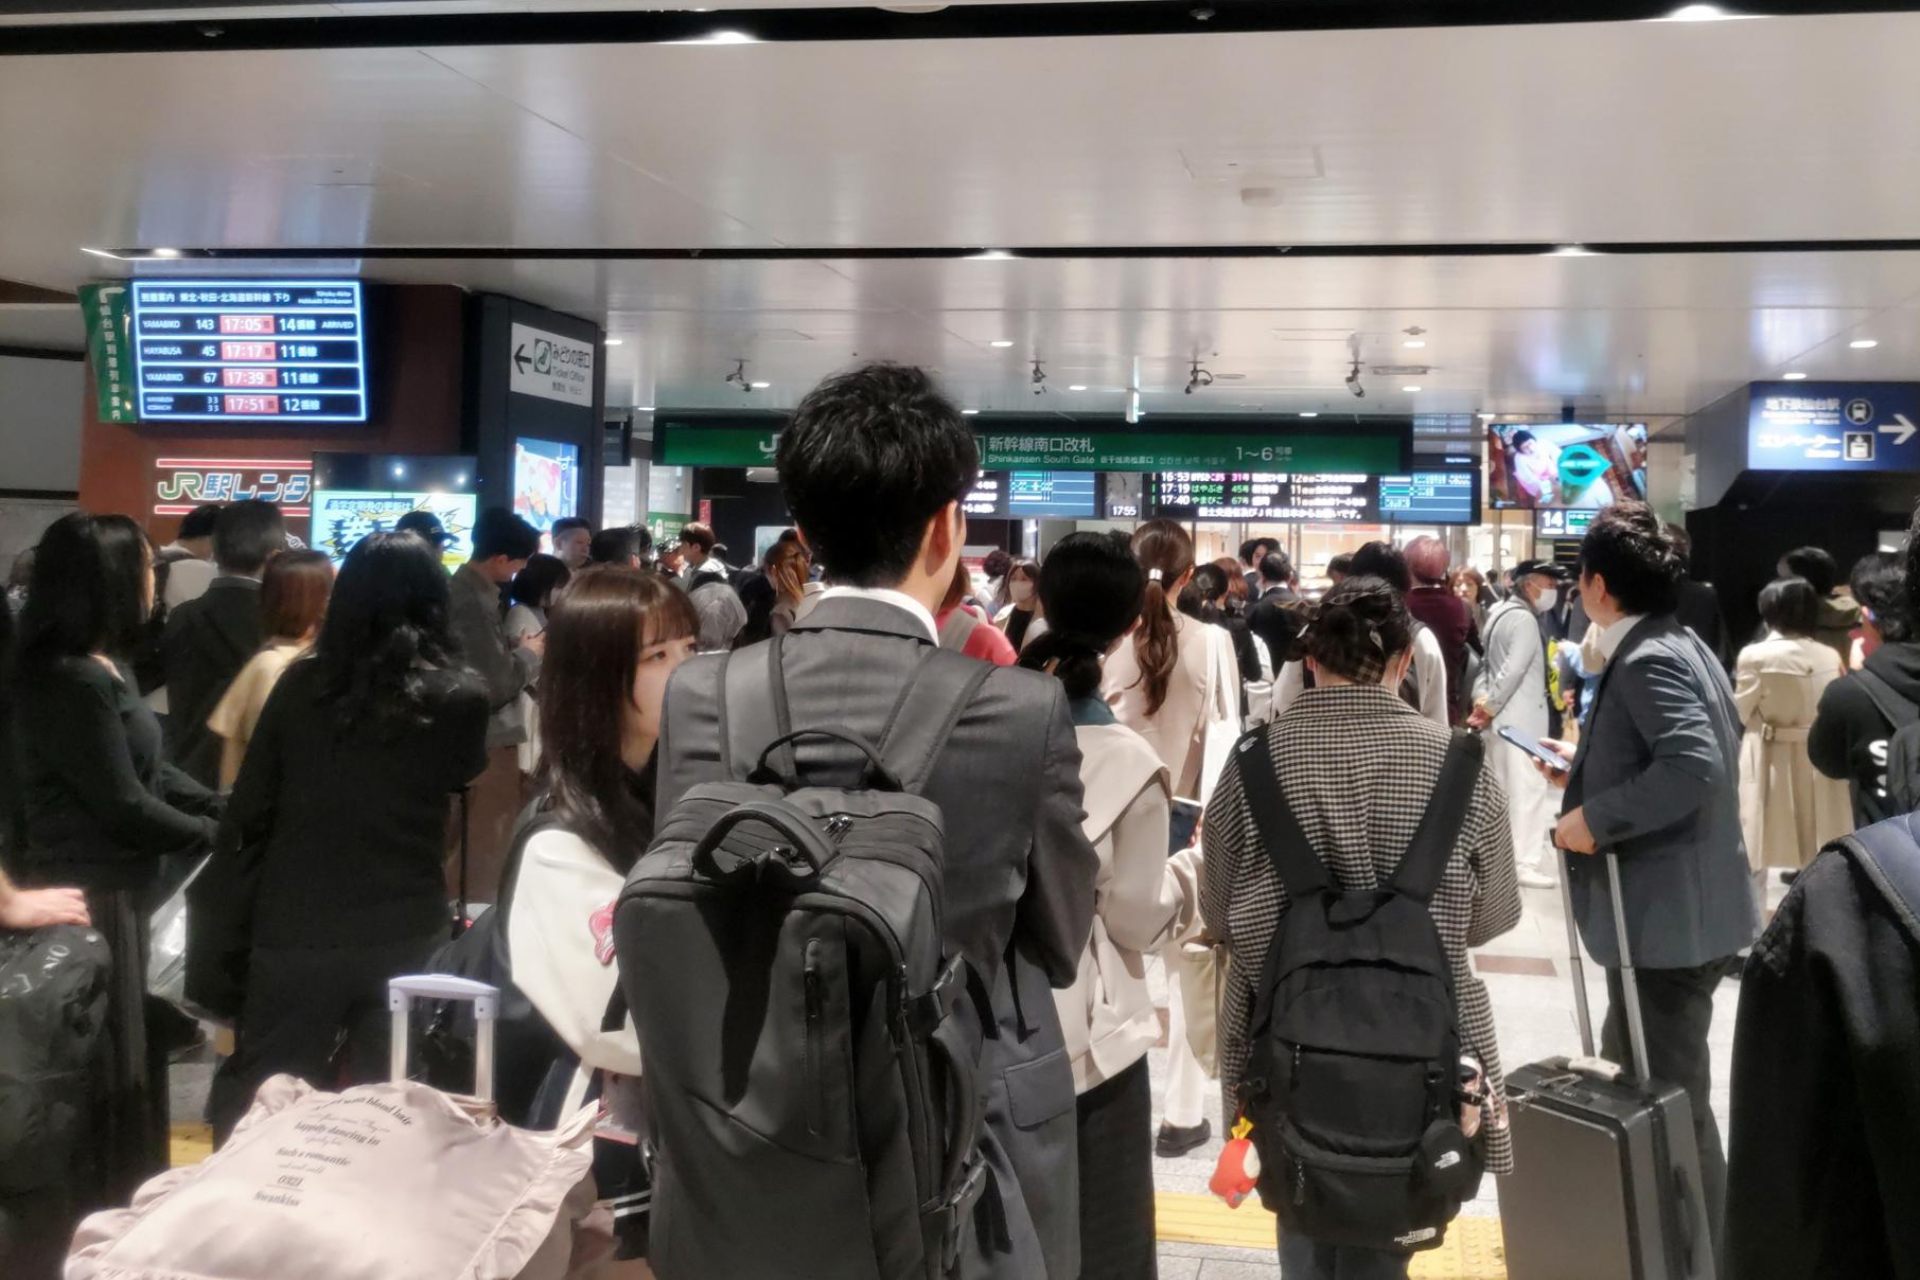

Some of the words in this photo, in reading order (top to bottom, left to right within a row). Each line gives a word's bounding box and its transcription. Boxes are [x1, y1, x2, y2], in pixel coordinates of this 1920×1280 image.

[195, 318, 215, 331] 143
[225, 318, 262, 331] 17:05
[321, 320, 355, 329] ARRIVED
[202, 345, 216, 357] 45
[226, 345, 263, 357] 17:17
[203, 372, 217, 383] 67
[228, 371, 265, 384] 17:39
[229, 398, 265, 411] 17:51
[988, 436, 1095, 453] 新幹線南口改札
[988, 454, 1041, 464] Shinkansen
[1043, 454, 1070, 464] South
[1072, 454, 1095, 464] Gate
[1161, 471, 1190, 482] 16:53
[1161, 483, 1190, 494] 17:19
[1191, 484, 1223, 494] はやぶさ
[1161, 495, 1190, 505] 17:40
[1191, 496, 1223, 505] やまびこ
[1543, 510, 1564, 528] 14
